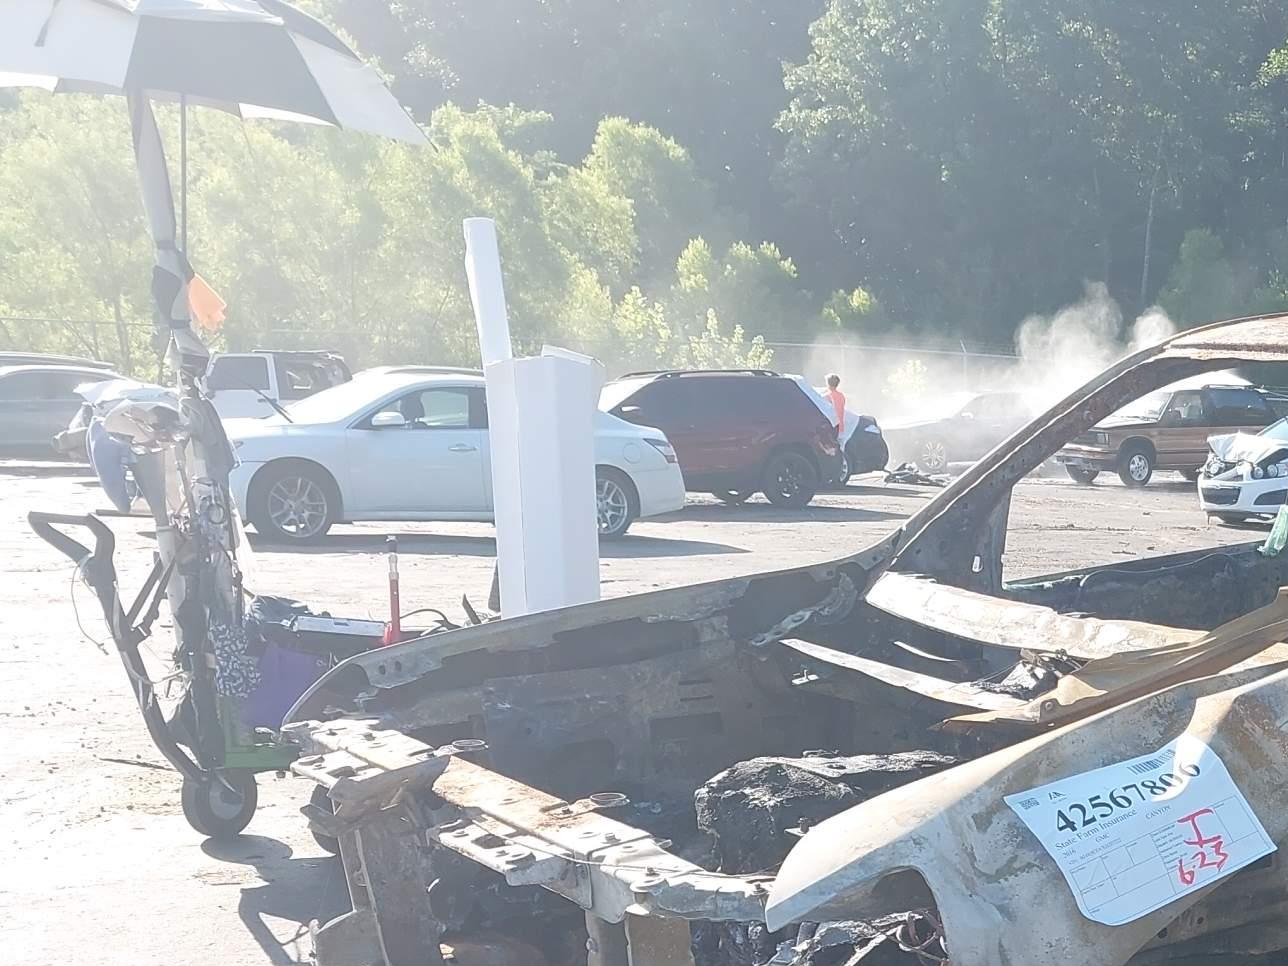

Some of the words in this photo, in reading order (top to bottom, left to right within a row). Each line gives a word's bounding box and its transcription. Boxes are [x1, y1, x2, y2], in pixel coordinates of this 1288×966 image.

[1056, 764, 1201, 832] 42567806
[1055, 836, 1077, 850] State
[1077, 826, 1099, 841] Farm
[1099, 808, 1137, 831] Insurance
